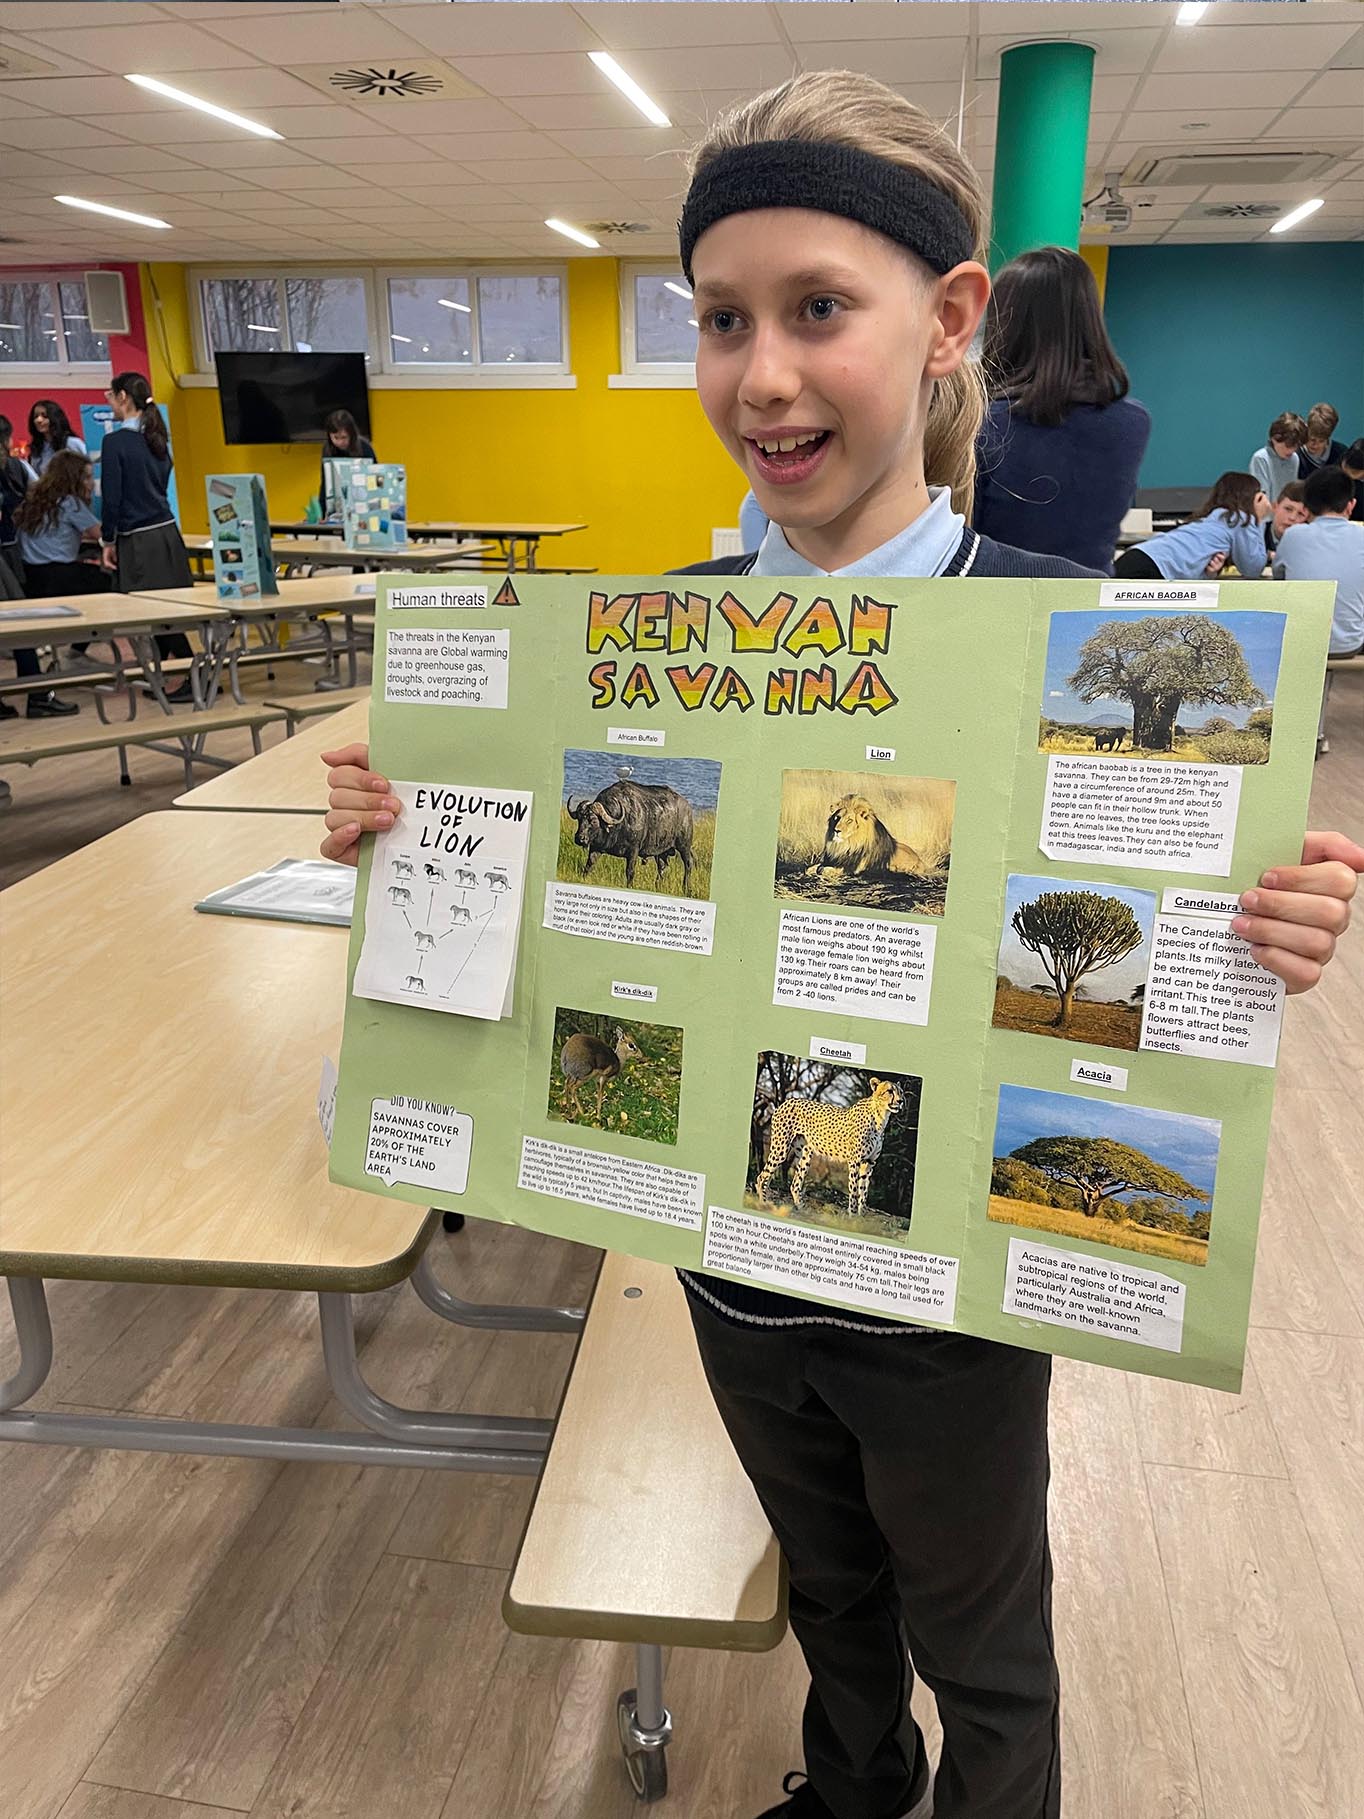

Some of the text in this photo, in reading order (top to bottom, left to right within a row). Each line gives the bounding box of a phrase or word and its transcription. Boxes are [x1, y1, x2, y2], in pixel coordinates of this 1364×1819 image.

[393, 592, 485, 606] Human threats
[586, 591, 898, 658] KENYAN
[389, 631, 495, 644] The threats in the Kenyan
[440, 646, 468, 656] Global
[470, 647, 507, 660] warming
[387, 659, 485, 673] due to greenhouse gas,
[387, 673, 488, 687] droughts, overgrazing of
[589, 661, 899, 716] SAVANNA
[386, 686, 482, 702] livestock and poaching.
[871, 749, 890, 757] Lion
[1090, 772, 1109, 782] They
[1193, 778, 1210, 787] high
[1099, 763, 1128, 771] baobab
[1188, 768, 1218, 777] kenyan
[416, 789, 527, 822] EVOLUTION
[441, 815, 463, 827] OF
[420, 826, 484, 857] LION
[1175, 897, 1238, 911] Candelabra
[782, 912, 809, 922] African
[811, 916, 832, 925] Lions
[876, 924, 888, 932] the
[1159, 923, 1178, 934] The
[802, 925, 830, 936] famous
[888, 937, 920, 948] average
[1156, 938, 1195, 948] species
[1198, 941, 1209, 950] of
[1205, 954, 1232, 968] milky
[1234, 958, 1259, 969] latex
[1153, 961, 1166, 971] be
[1169, 965, 1220, 979] extremely
[1222, 968, 1277, 985] poisonous
[1152, 976, 1277, 998] and can be dangerously
[1149, 1000, 1165, 1010] 6-8
[1222, 1010, 1254, 1022] plants
[1210, 995, 1233, 1005] tree
[1234, 997, 1244, 1007] is
[1245, 1001, 1276, 1012] about
[1148, 1012, 1183, 1025] flowers
[1186, 1019, 1219, 1030] attract
[1144, 1037, 1182, 1051] insects.
[1146, 1025, 1248, 1047] butterflies and other
[820, 1047, 851, 1057] Cheetah
[1077, 1067, 1111, 1080] Acacia
[391, 1096, 455, 1116] DID YOU KNOW?
[373, 1111, 458, 1136] SAVANNAS COVER
[371, 1124, 451, 1147] APPROXIMATELY
[370, 1136, 424, 1155] 20% OF THE
[367, 1162, 390, 1175] AREA
[369, 1149, 435, 1170] EARTH'S LAND
[711, 1210, 724, 1219] The
[725, 1215, 751, 1226] cheetah
[760, 1222, 771, 1230] the
[798, 1230, 821, 1241] fastest
[823, 1235, 838, 1245] land
[840, 1240, 864, 1250] animal
[865, 1246, 897, 1257] reaching
[899, 1252, 927, 1262] speeds
[1018, 1264, 1068, 1281] subtropical
[1070, 1276, 1105, 1290] regions
[1107, 1284, 1118, 1292] of
[1120, 1286, 1135, 1297] the
[1021, 1251, 1179, 1293] Acacias are native to tropical and
[1016, 1276, 1066, 1294] particularly
[1069, 1288, 1110, 1304] Australia
[1113, 1299, 1132, 1308] and
[1014, 1298, 1061, 1317] landmarks
[1064, 1311, 1076, 1320] on
[1079, 1314, 1094, 1326] the
[1015, 1287, 1141, 1322] where they are well-known
